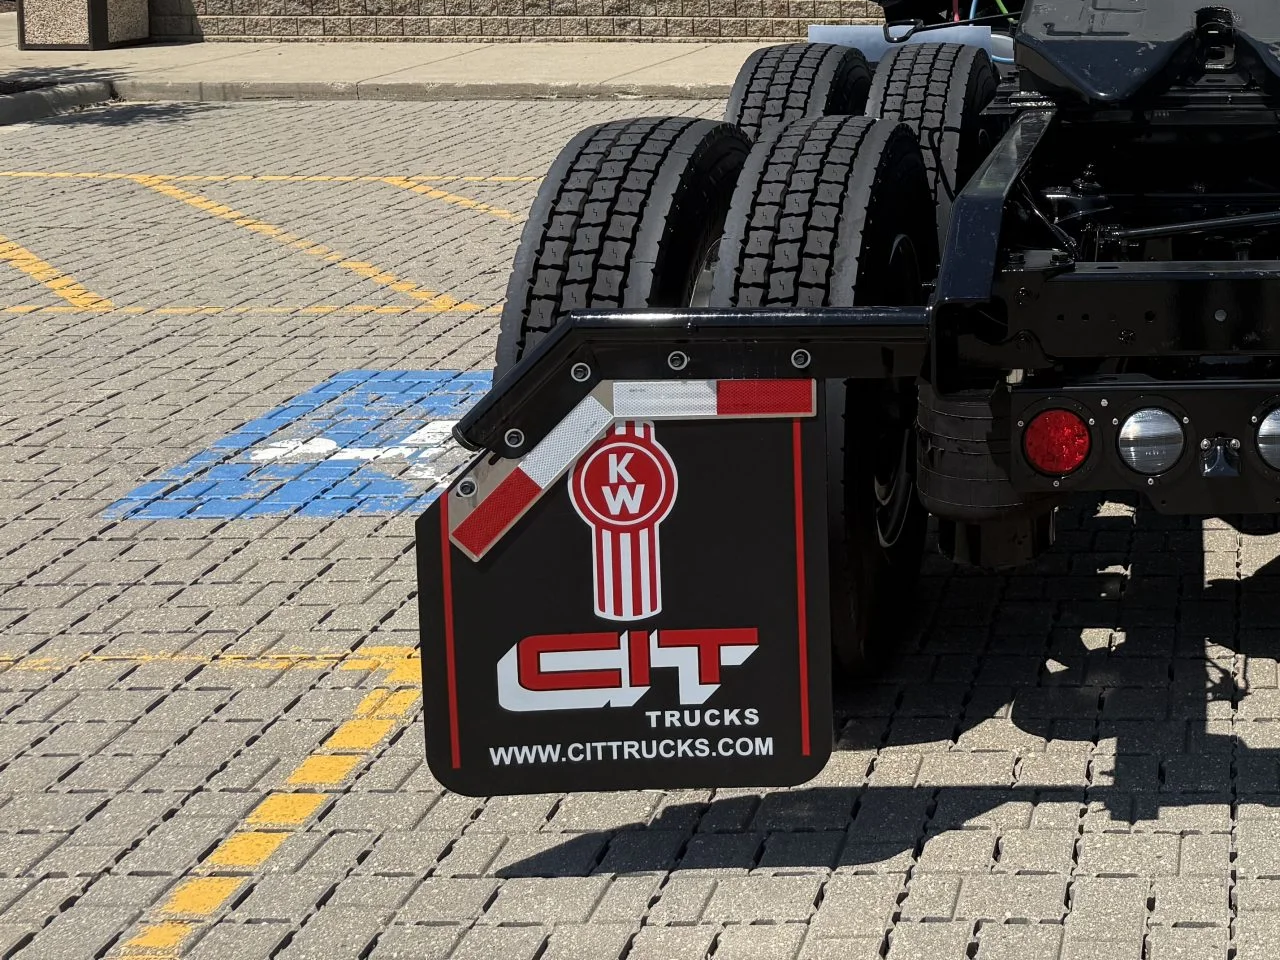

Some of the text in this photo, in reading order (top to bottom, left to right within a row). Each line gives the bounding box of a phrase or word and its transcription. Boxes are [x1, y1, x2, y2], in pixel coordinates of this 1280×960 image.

[497, 628, 759, 712] CIT
[645, 708, 760, 728] TRUCKS
[489, 737, 774, 766] WWW.CITTRUCKS.COM
